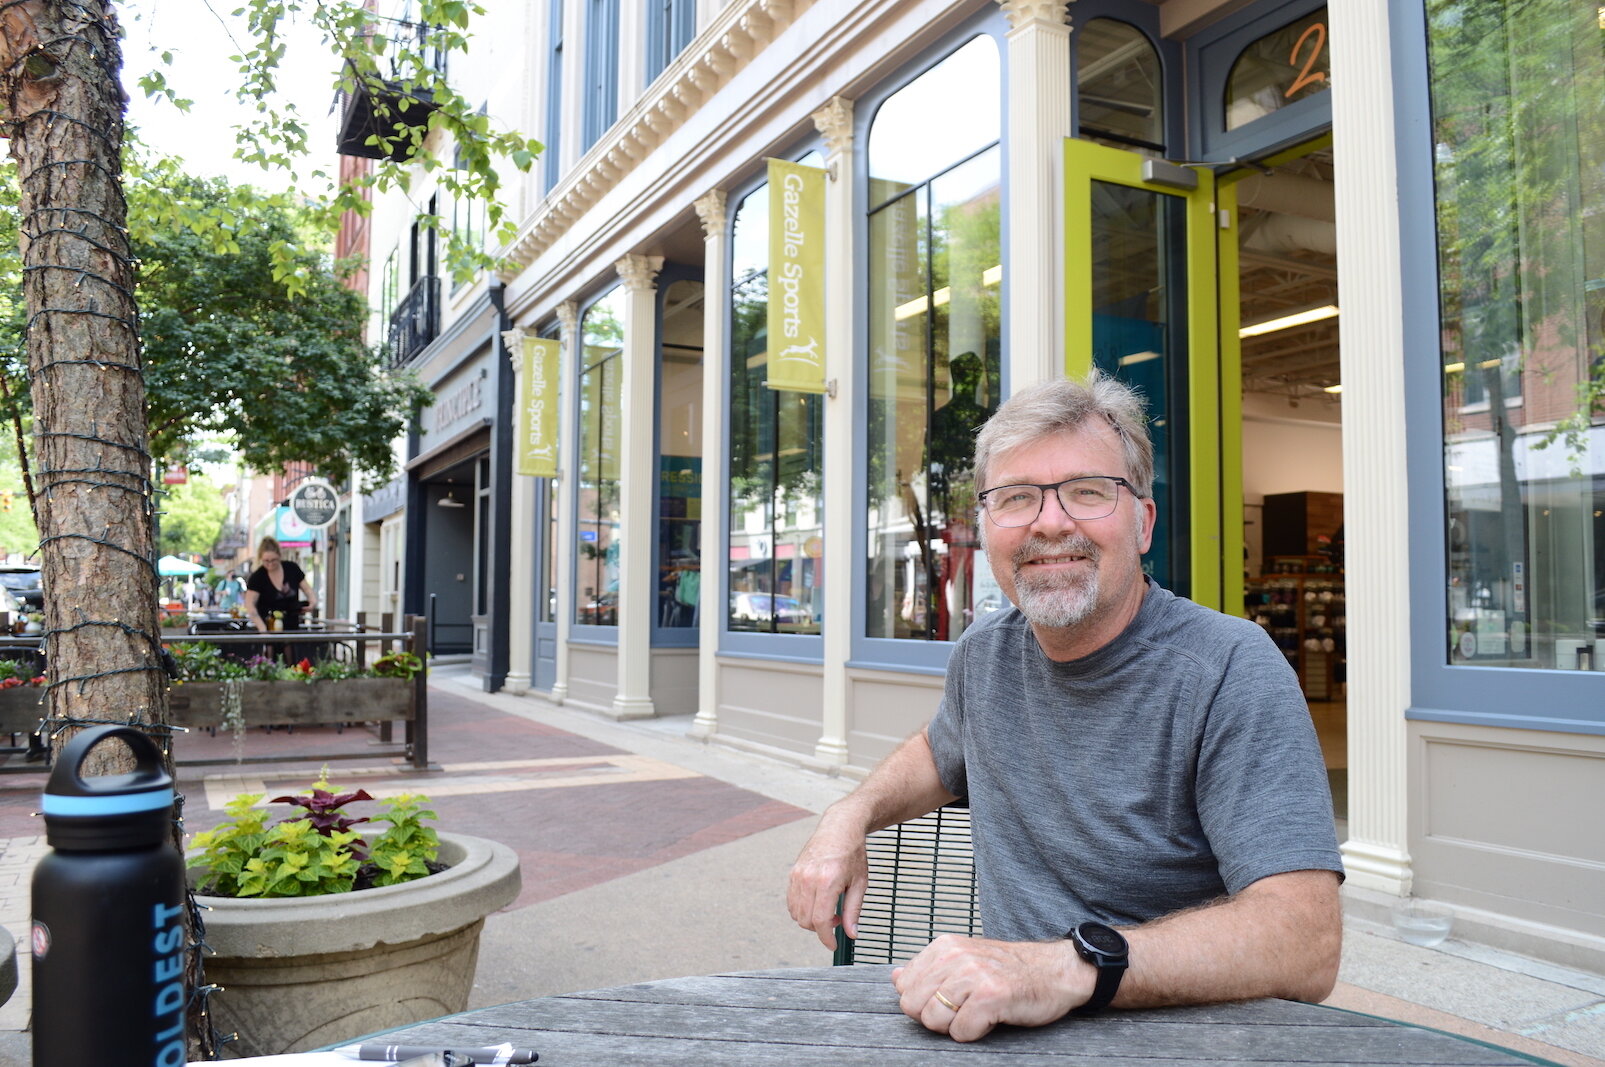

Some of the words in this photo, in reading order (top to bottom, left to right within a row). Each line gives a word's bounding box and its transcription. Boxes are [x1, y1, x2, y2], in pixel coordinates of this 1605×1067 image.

[1284, 23, 1326, 98] 2
[783, 173, 804, 258] Gazelle
[778, 262, 804, 338] Sports
[531, 345, 546, 397] Gazelle
[527, 399, 545, 446] Sports
[661, 470, 702, 484] RESSI
